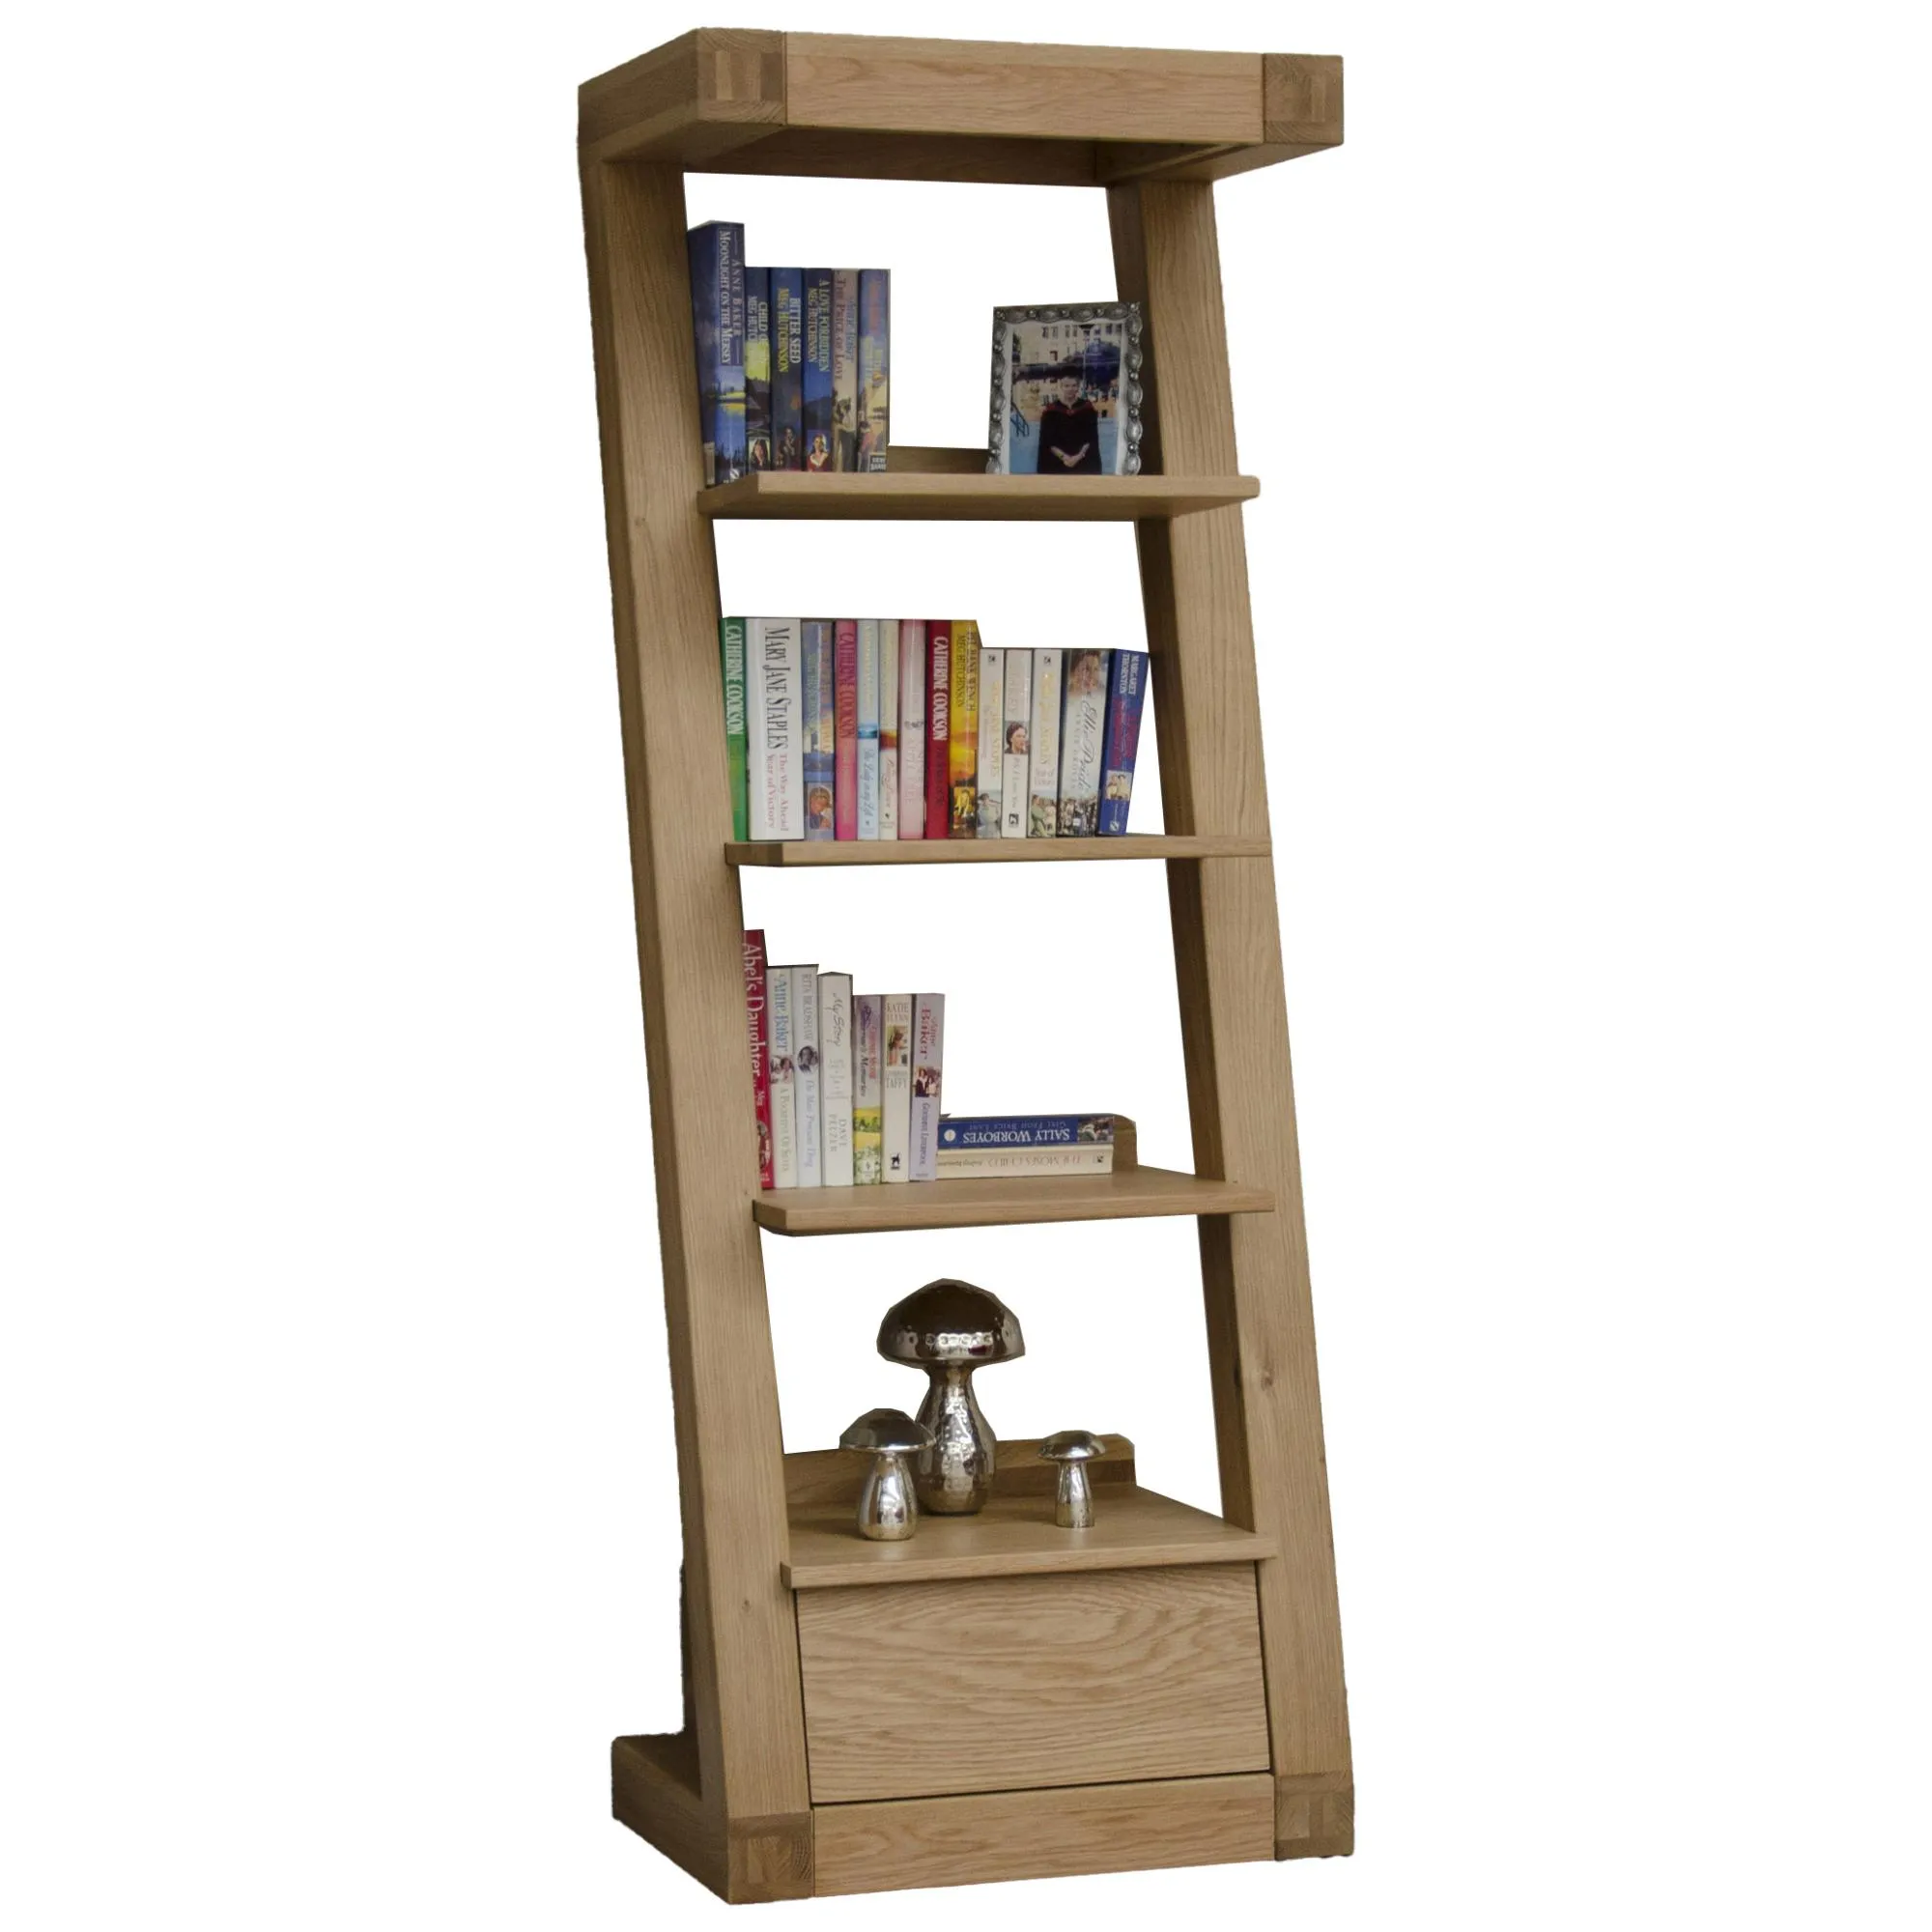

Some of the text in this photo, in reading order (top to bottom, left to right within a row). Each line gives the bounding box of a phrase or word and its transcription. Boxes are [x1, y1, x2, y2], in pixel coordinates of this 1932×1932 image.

[720, 230, 733, 365] MOONLIGHT ON THE MERSEY
[732, 259, 743, 337] ANNE BAKER
[747, 296, 758, 316] MEG
[758, 301, 768, 329] CHILD
[819, 288, 830, 313] LOVE
[777, 287, 789, 372] MEG HUTCHINSON
[789, 298, 802, 363] BITTER SEED
[808, 287, 817, 362] MEG HUTCHINSON
[819, 315, 830, 372] FORBIDDEN
[725, 625, 743, 681] CATHERINE
[838, 633, 855, 687] CATHERINE
[932, 637, 948, 689] CATHERINE
[1127, 654, 1139, 696] MARGARET
[762, 627, 791, 750] MARY JANE STAPLES
[956, 654, 965, 707] HUTCHINSON
[726, 684, 745, 734] COOKSON
[838, 691, 855, 739] COOKSON
[932, 693, 948, 740] COOKSON
[1077, 700, 1097, 792] Ellie Pride
[779, 775, 788, 793] Way
[780, 799, 789, 831] Ahead
[743, 943, 765, 1077] Abel's Daughter
[773, 975, 789, 1052] Anne Baker
[919, 1003, 932, 1060] Baker
[838, 1119, 847, 1149] DAVE
[962, 1128, 1070, 1143] SALLY WORBOYES
